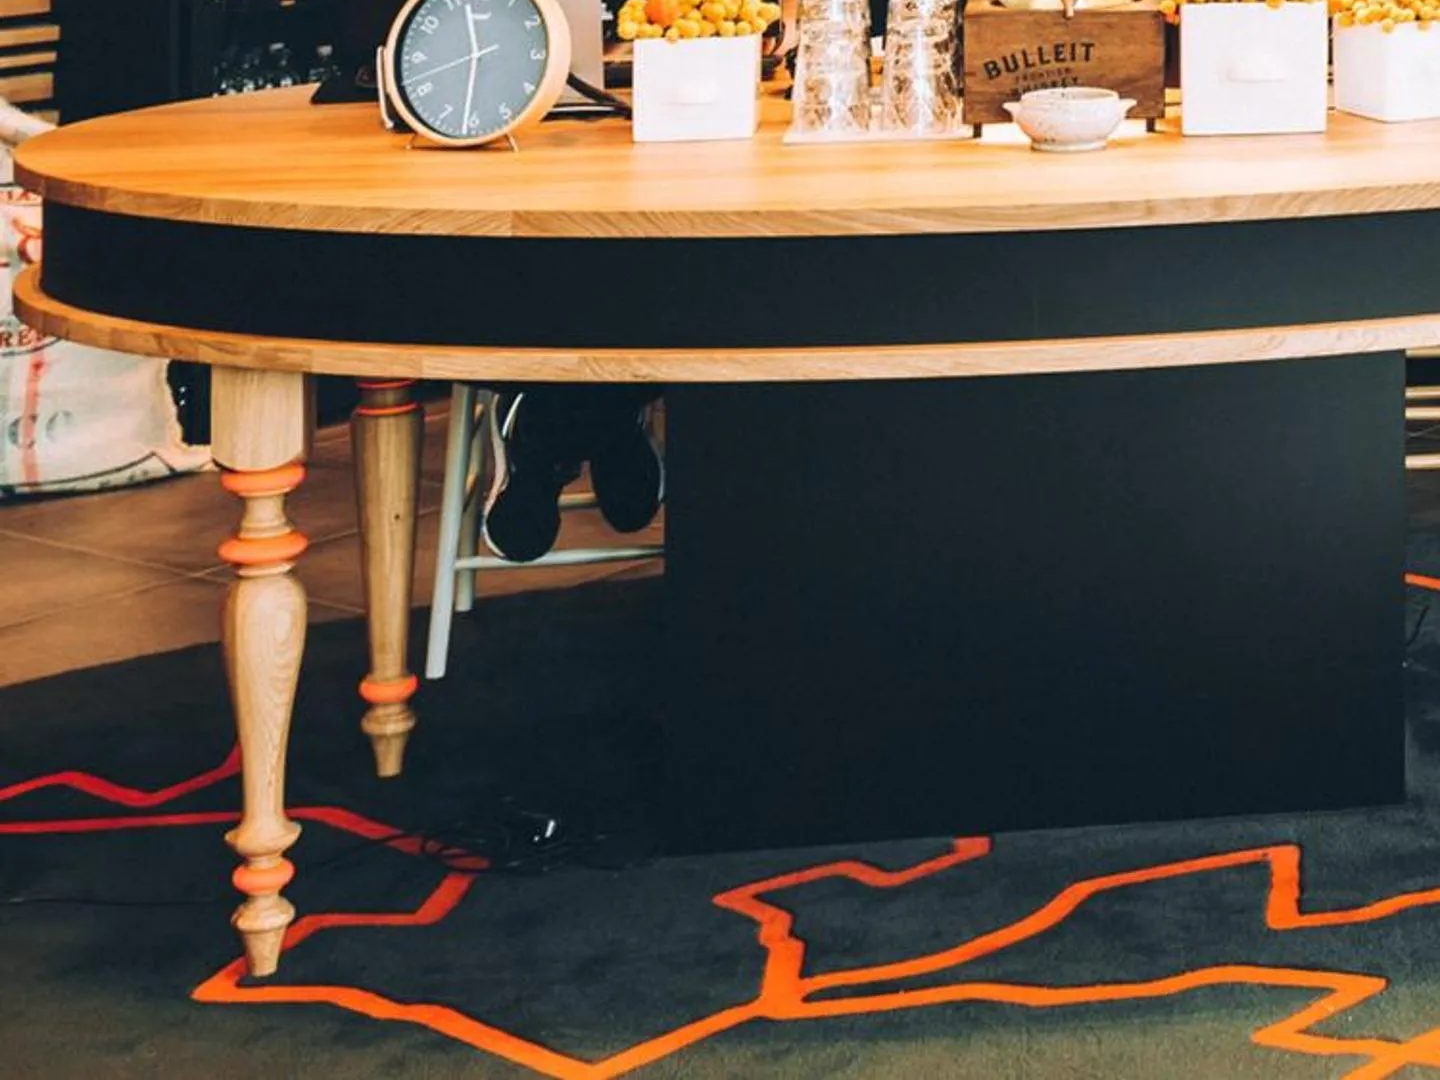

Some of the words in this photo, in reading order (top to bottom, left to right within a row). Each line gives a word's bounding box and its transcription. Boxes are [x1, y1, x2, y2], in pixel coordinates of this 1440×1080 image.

[420, 16, 440, 35] 10
[524, 16, 541, 30] 2
[411, 51, 429, 65] 9
[530, 49, 546, 61] 3
[984, 42, 1096, 81] BULLEIT
[417, 82, 434, 97] 8
[523, 81, 536, 95] 4
[439, 103, 454, 120] 7
[499, 104, 512, 120] 5
